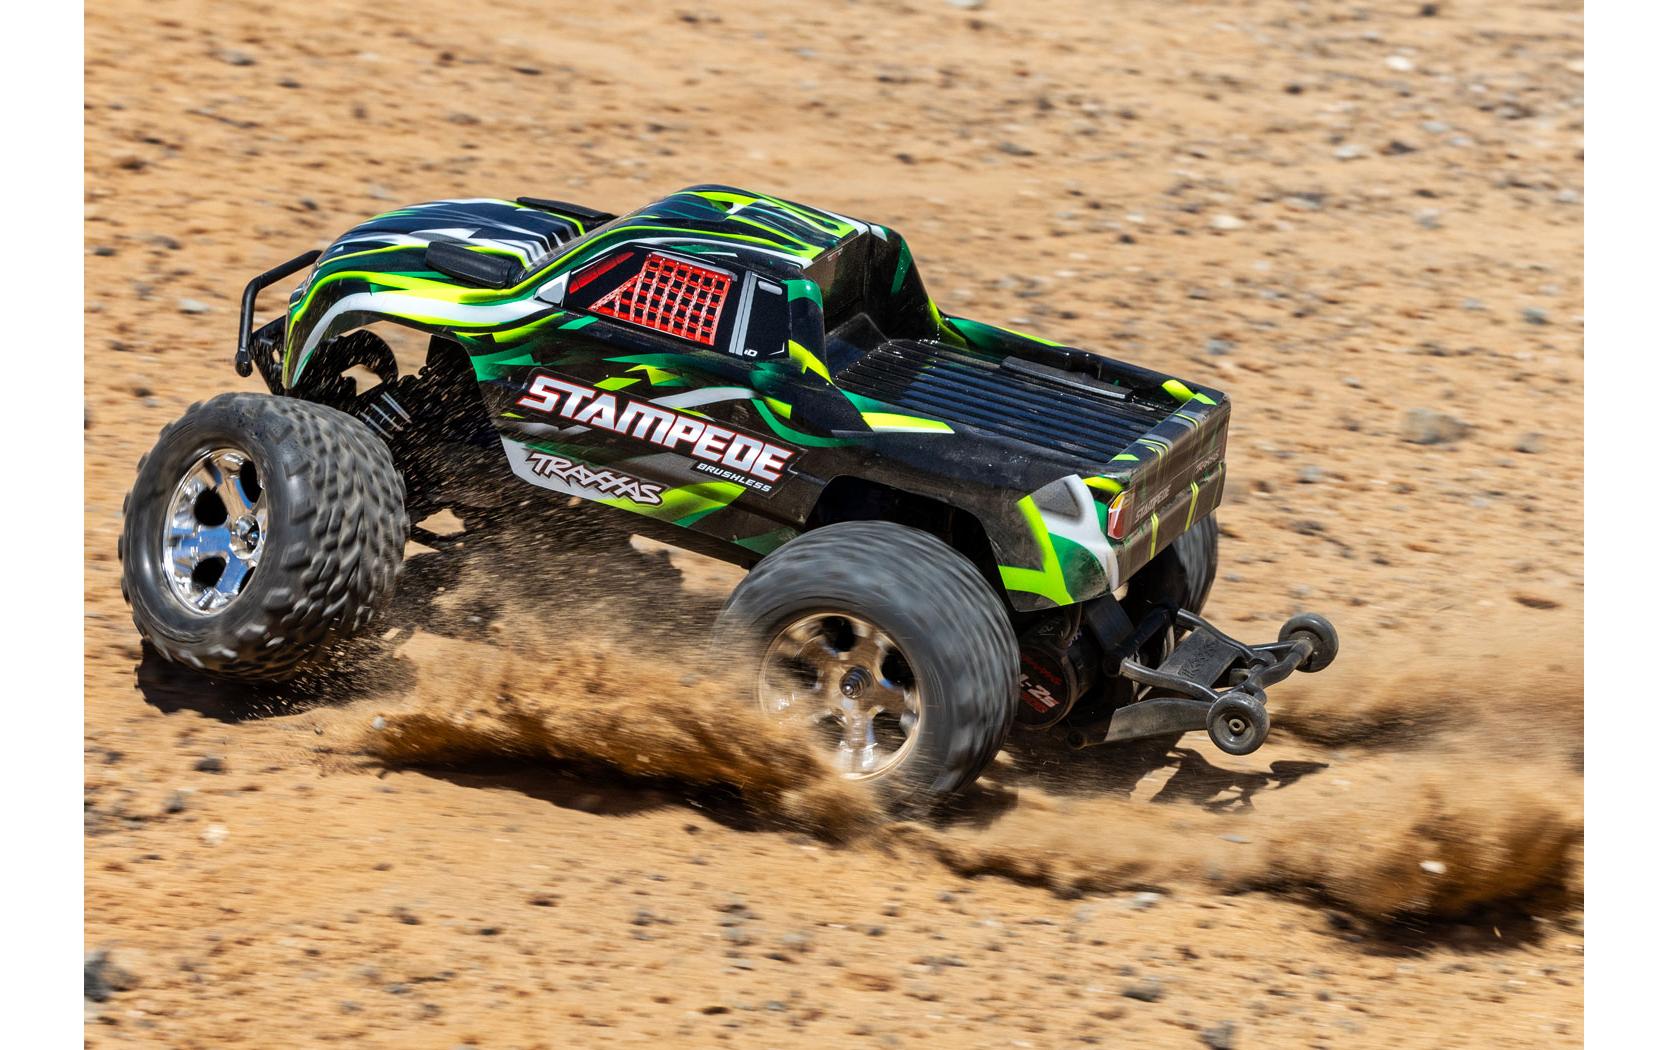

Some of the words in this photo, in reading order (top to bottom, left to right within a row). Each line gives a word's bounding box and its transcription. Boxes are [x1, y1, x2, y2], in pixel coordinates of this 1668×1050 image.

[515, 374, 794, 483] STAMPEDE
[527, 453, 663, 506] TRAXXAS
[696, 462, 772, 493] BRUSHLESS
